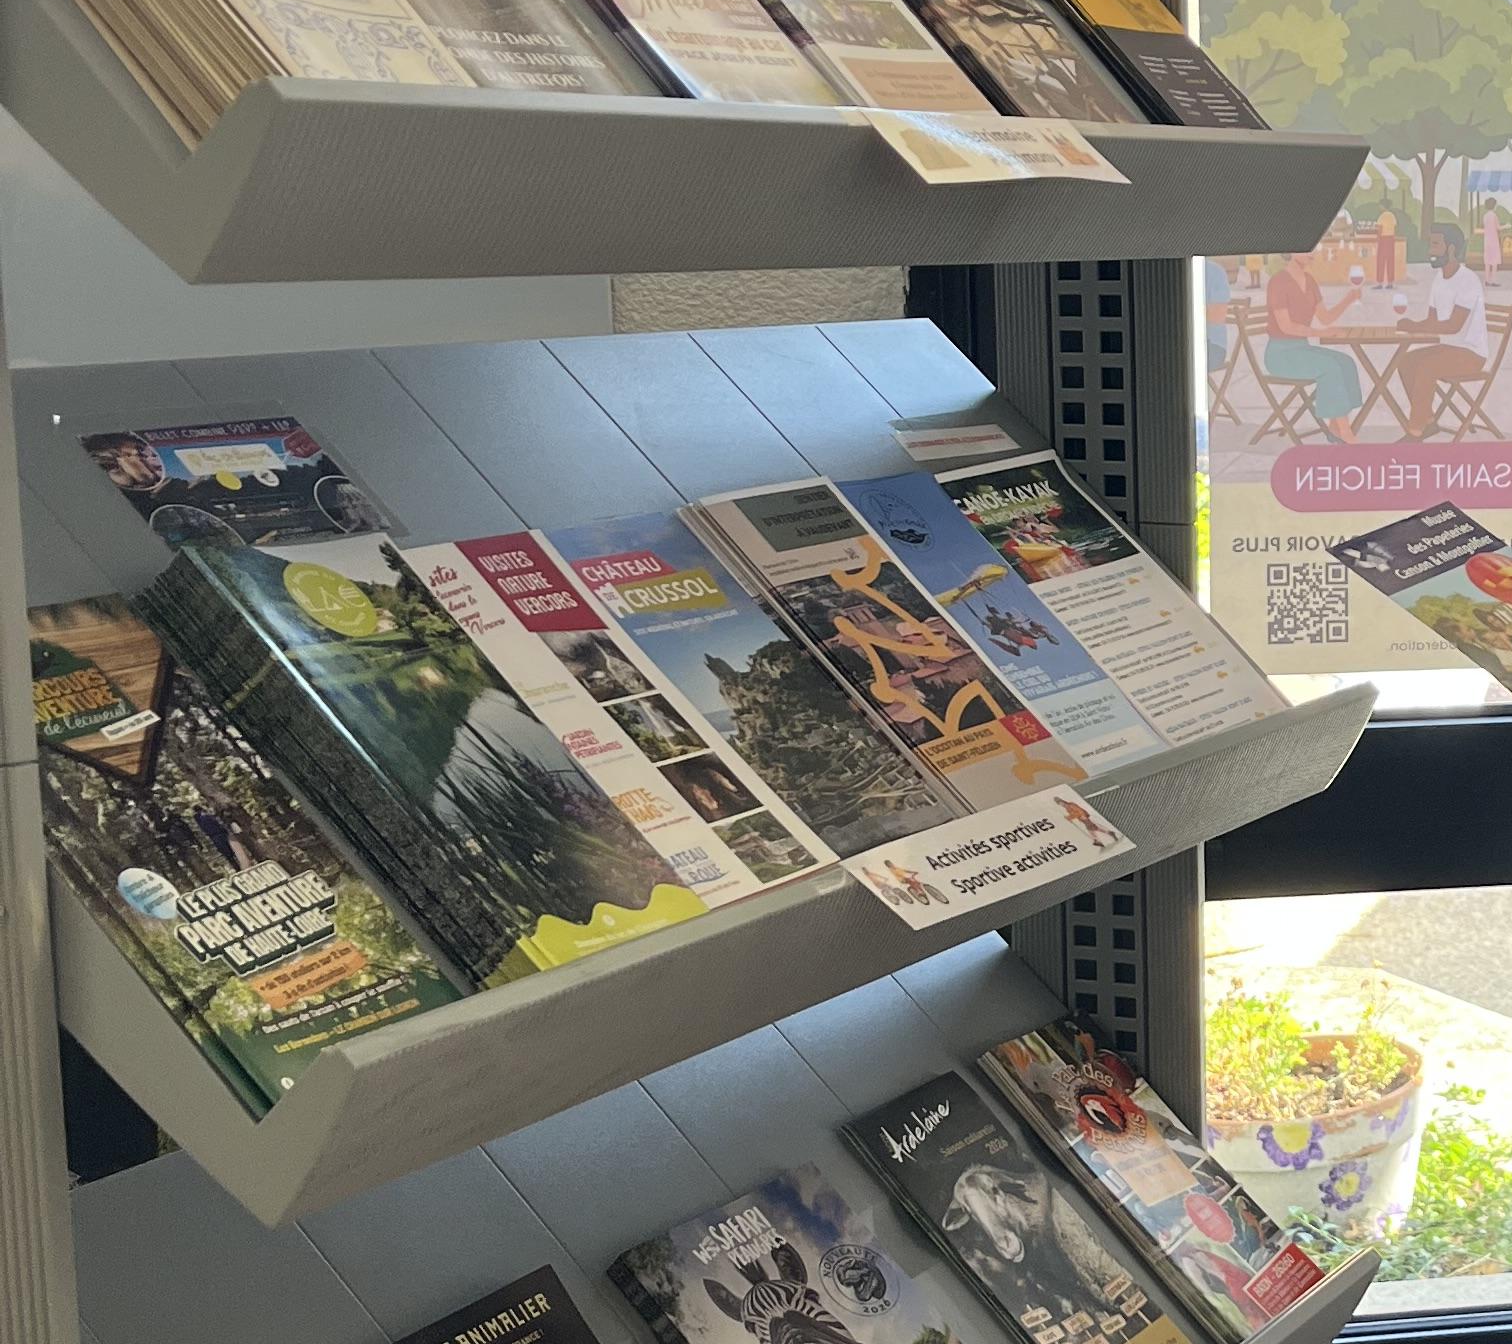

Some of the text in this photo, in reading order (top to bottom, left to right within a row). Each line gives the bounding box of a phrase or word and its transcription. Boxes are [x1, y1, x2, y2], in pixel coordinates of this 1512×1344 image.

[1407, 522, 1474, 555] des Papeteries
[1421, 508, 1457, 528] Musée
[479, 551, 534, 572] VISITES
[582, 555, 662, 584] CHÂTEAU
[1395, 534, 1494, 580] Canson Montgolfier
[497, 572, 553, 595] NATURE
[513, 592, 578, 616] VERCORS
[623, 577, 718, 608] CRUSSOL
[925, 817, 1055, 871] Activités sportives
[951, 839, 1079, 896] Sportive activities
[177, 910, 243, 954] PARC
[231, 872, 333, 933] AVENTURE
[178, 894, 201, 919] LE
[198, 880, 242, 908] PLUS
[233, 865, 288, 896] GRAND
[223, 908, 333, 967] DE HAUTE-LOIRE
[880, 1099, 951, 1163] Ardelaine
[709, 1206, 772, 1251] SAFARI
